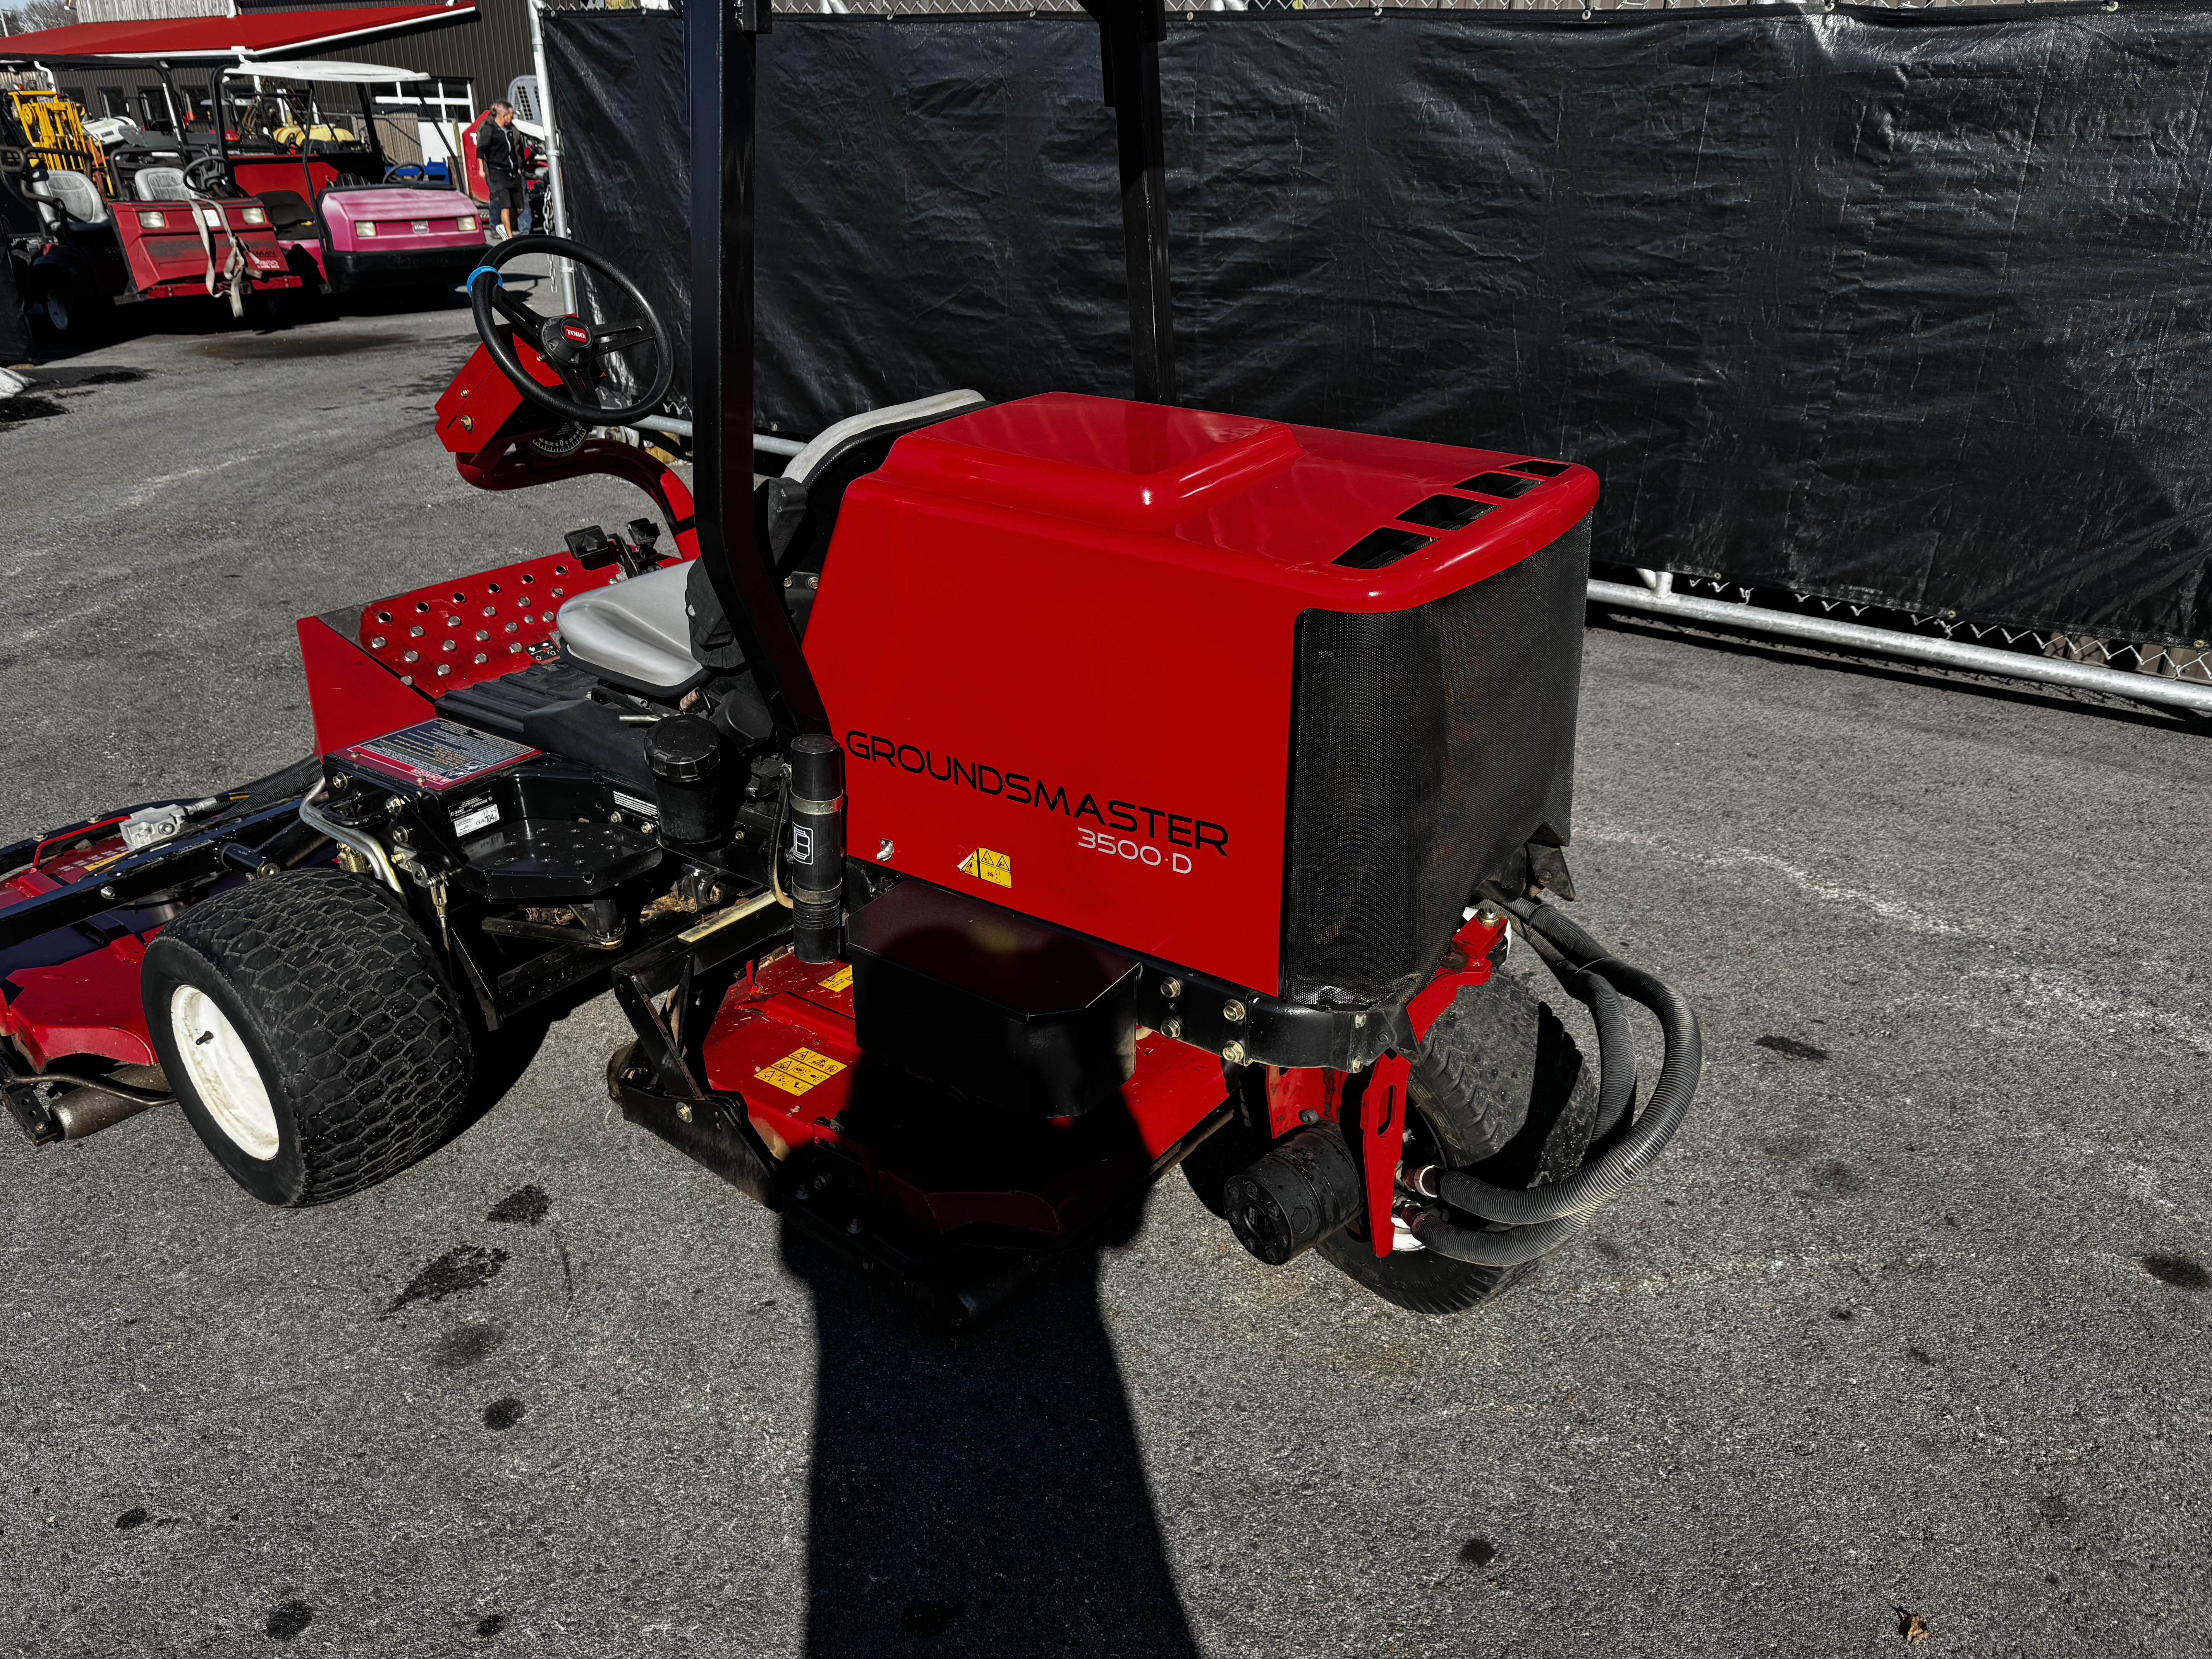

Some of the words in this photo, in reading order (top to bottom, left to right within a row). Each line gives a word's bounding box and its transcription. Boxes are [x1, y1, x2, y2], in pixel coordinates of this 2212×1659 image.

[566, 329, 585, 338] TORO
[410, 768, 442, 781] DANGER
[846, 730, 1229, 857] GROUNDSMASTER
